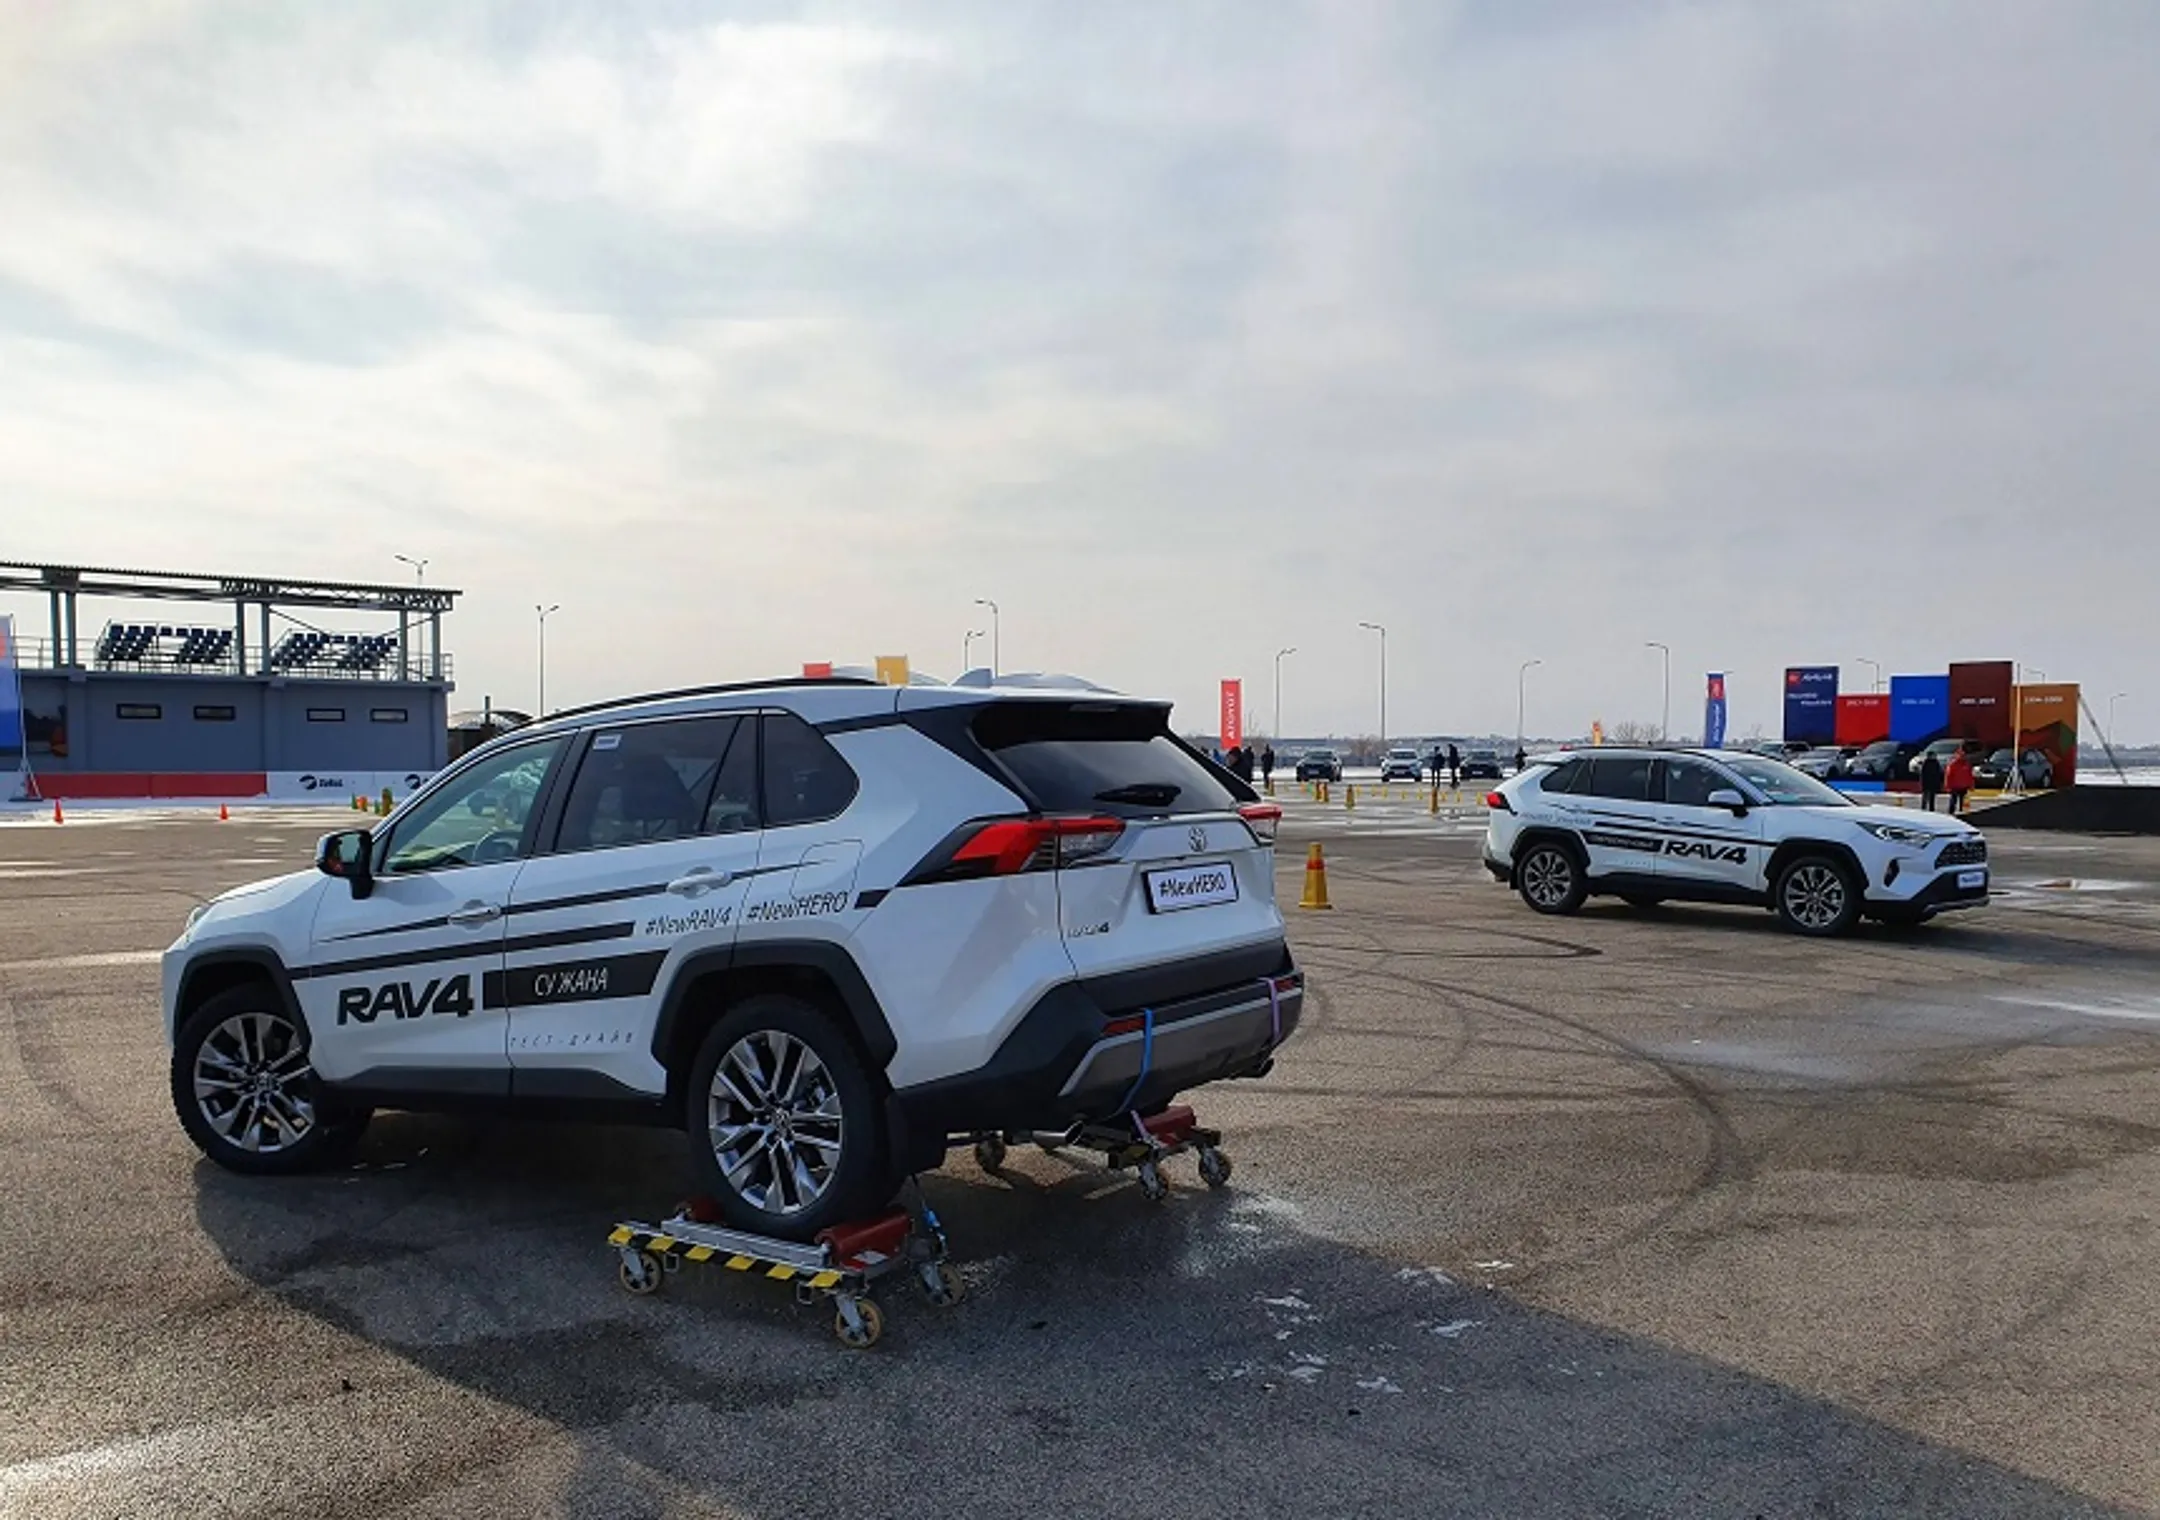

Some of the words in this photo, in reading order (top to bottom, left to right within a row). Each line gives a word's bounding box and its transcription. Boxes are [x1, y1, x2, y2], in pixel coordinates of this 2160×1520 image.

[1664, 840, 1747, 864] RAV4
[1159, 871, 1226, 898] #NewHERO
[646, 906, 732, 935] #NewRAV4
[747, 891, 848, 921] #NewHERO
[337, 974, 475, 1026] RAV4
